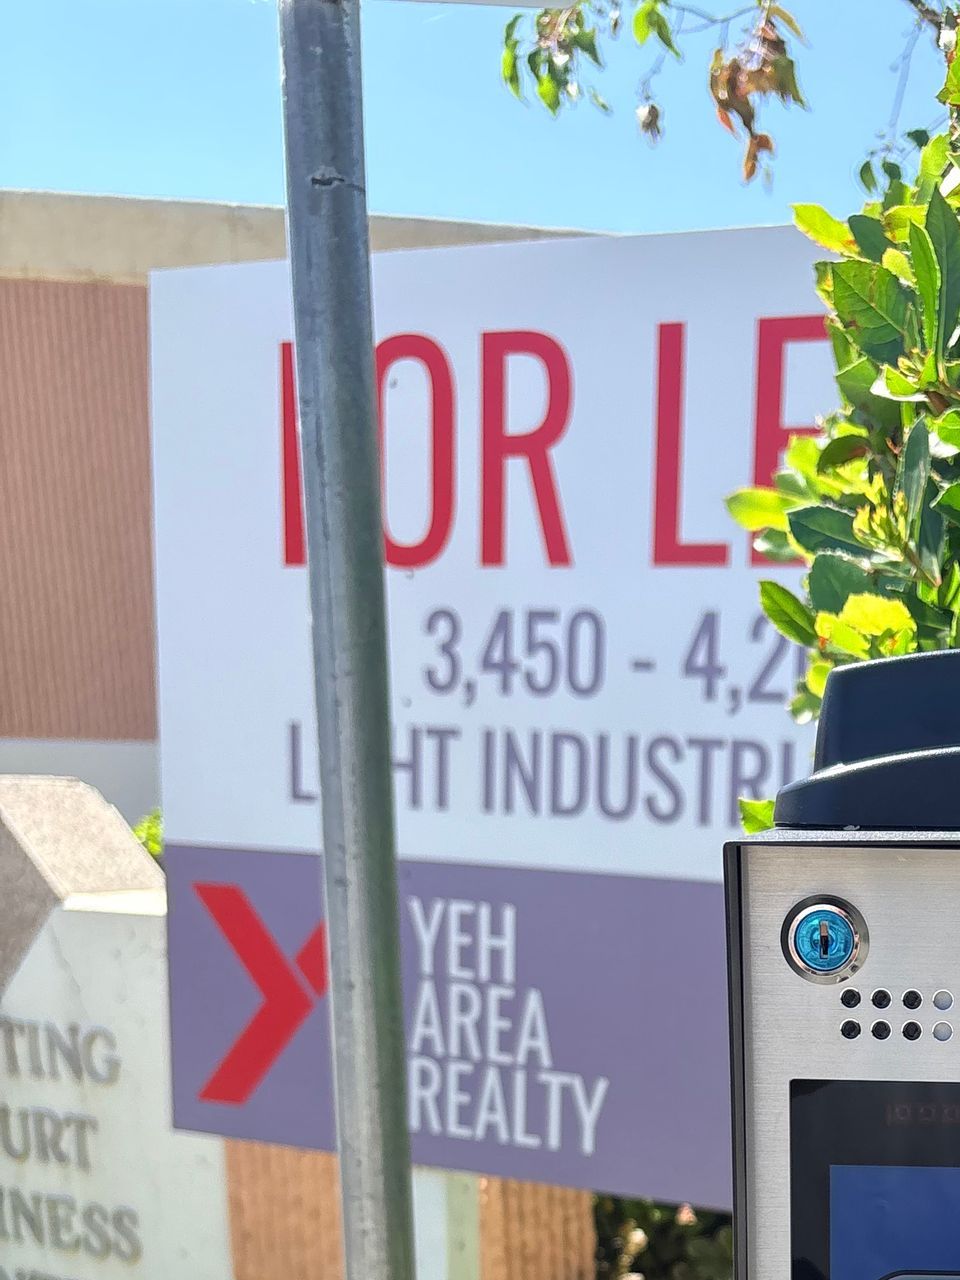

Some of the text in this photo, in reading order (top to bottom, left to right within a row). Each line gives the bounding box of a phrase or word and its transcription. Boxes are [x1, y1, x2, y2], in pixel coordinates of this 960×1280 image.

[424, 607, 606, 708] 3,450
[683, 608, 808, 717] 4,2
[407, 895, 516, 983] YEH
[411, 977, 552, 1069] AREA
[408, 1054, 610, 1157] REALTY
